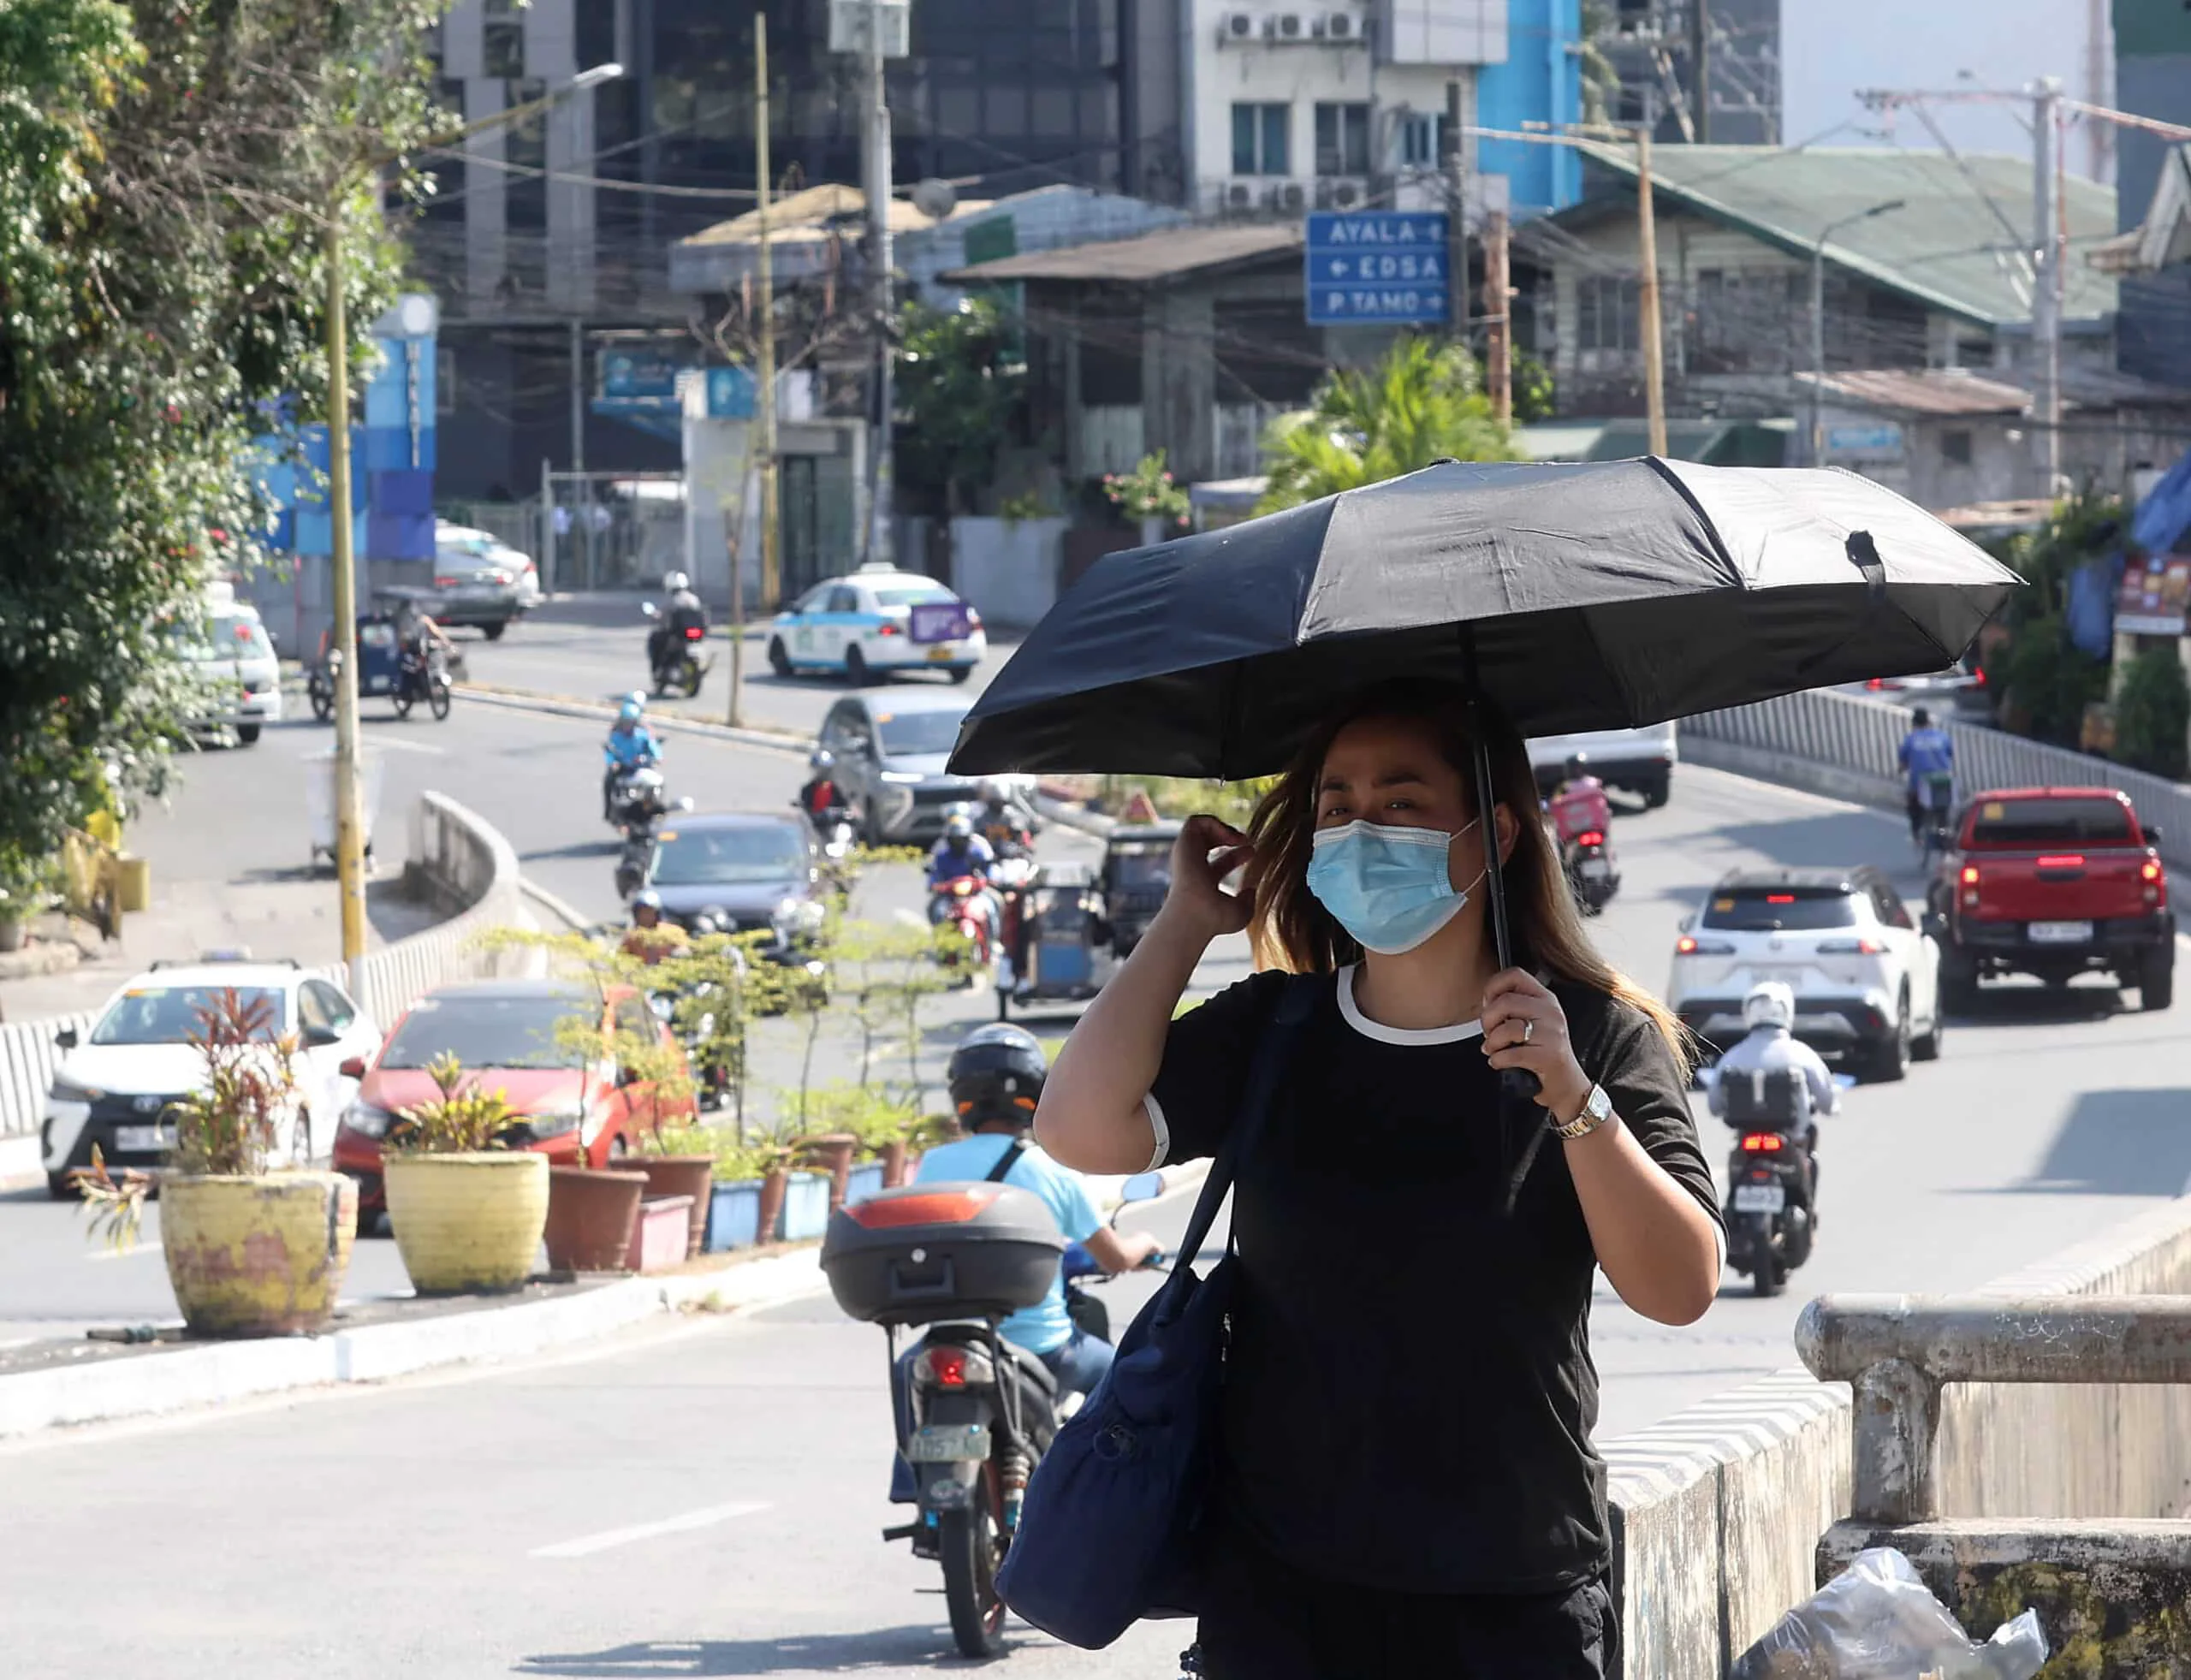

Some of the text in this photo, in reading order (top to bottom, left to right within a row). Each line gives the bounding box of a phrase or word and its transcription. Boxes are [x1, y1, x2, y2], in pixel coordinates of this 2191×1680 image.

[1329, 219, 1416, 244] AYALA
[1358, 255, 1440, 280] EDSA
[1351, 291, 1420, 314] TAMO
